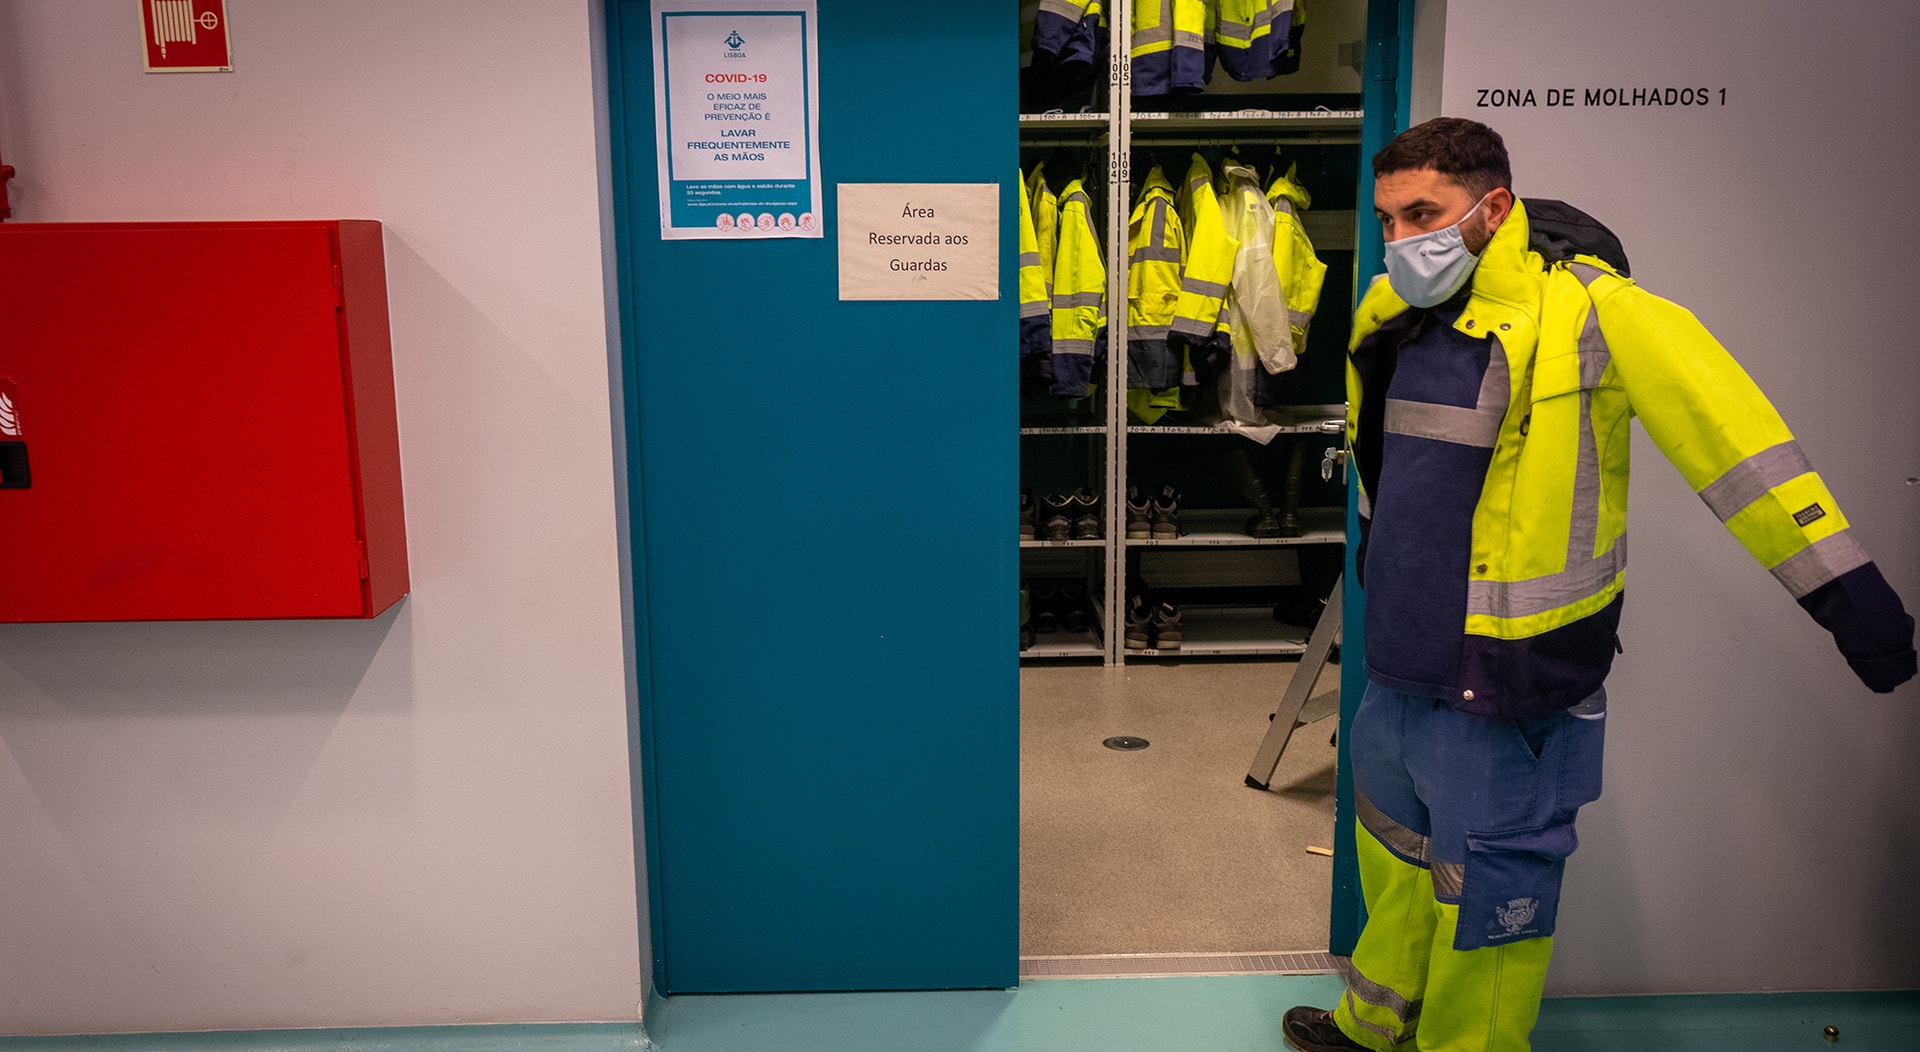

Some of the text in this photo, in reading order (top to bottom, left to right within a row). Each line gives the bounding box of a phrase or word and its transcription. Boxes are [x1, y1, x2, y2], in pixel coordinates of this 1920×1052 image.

[705, 73, 767, 83] COVID-19
[707, 93, 715, 101] O
[743, 92, 767, 100] MAIS
[1476, 88, 1727, 107] ZONA DE MOLHADOS 1
[713, 103, 746, 111] EFICAZ
[704, 112, 771, 121] PREVENÇÃO É
[720, 129, 756, 137] LAVAR
[687, 141, 790, 150] FREQUENTEMENTE
[714, 152, 765, 161] AS MÃOS
[902, 202, 935, 218] Área
[869, 232, 969, 245] Reservada aos
[889, 258, 948, 271] Guardas
